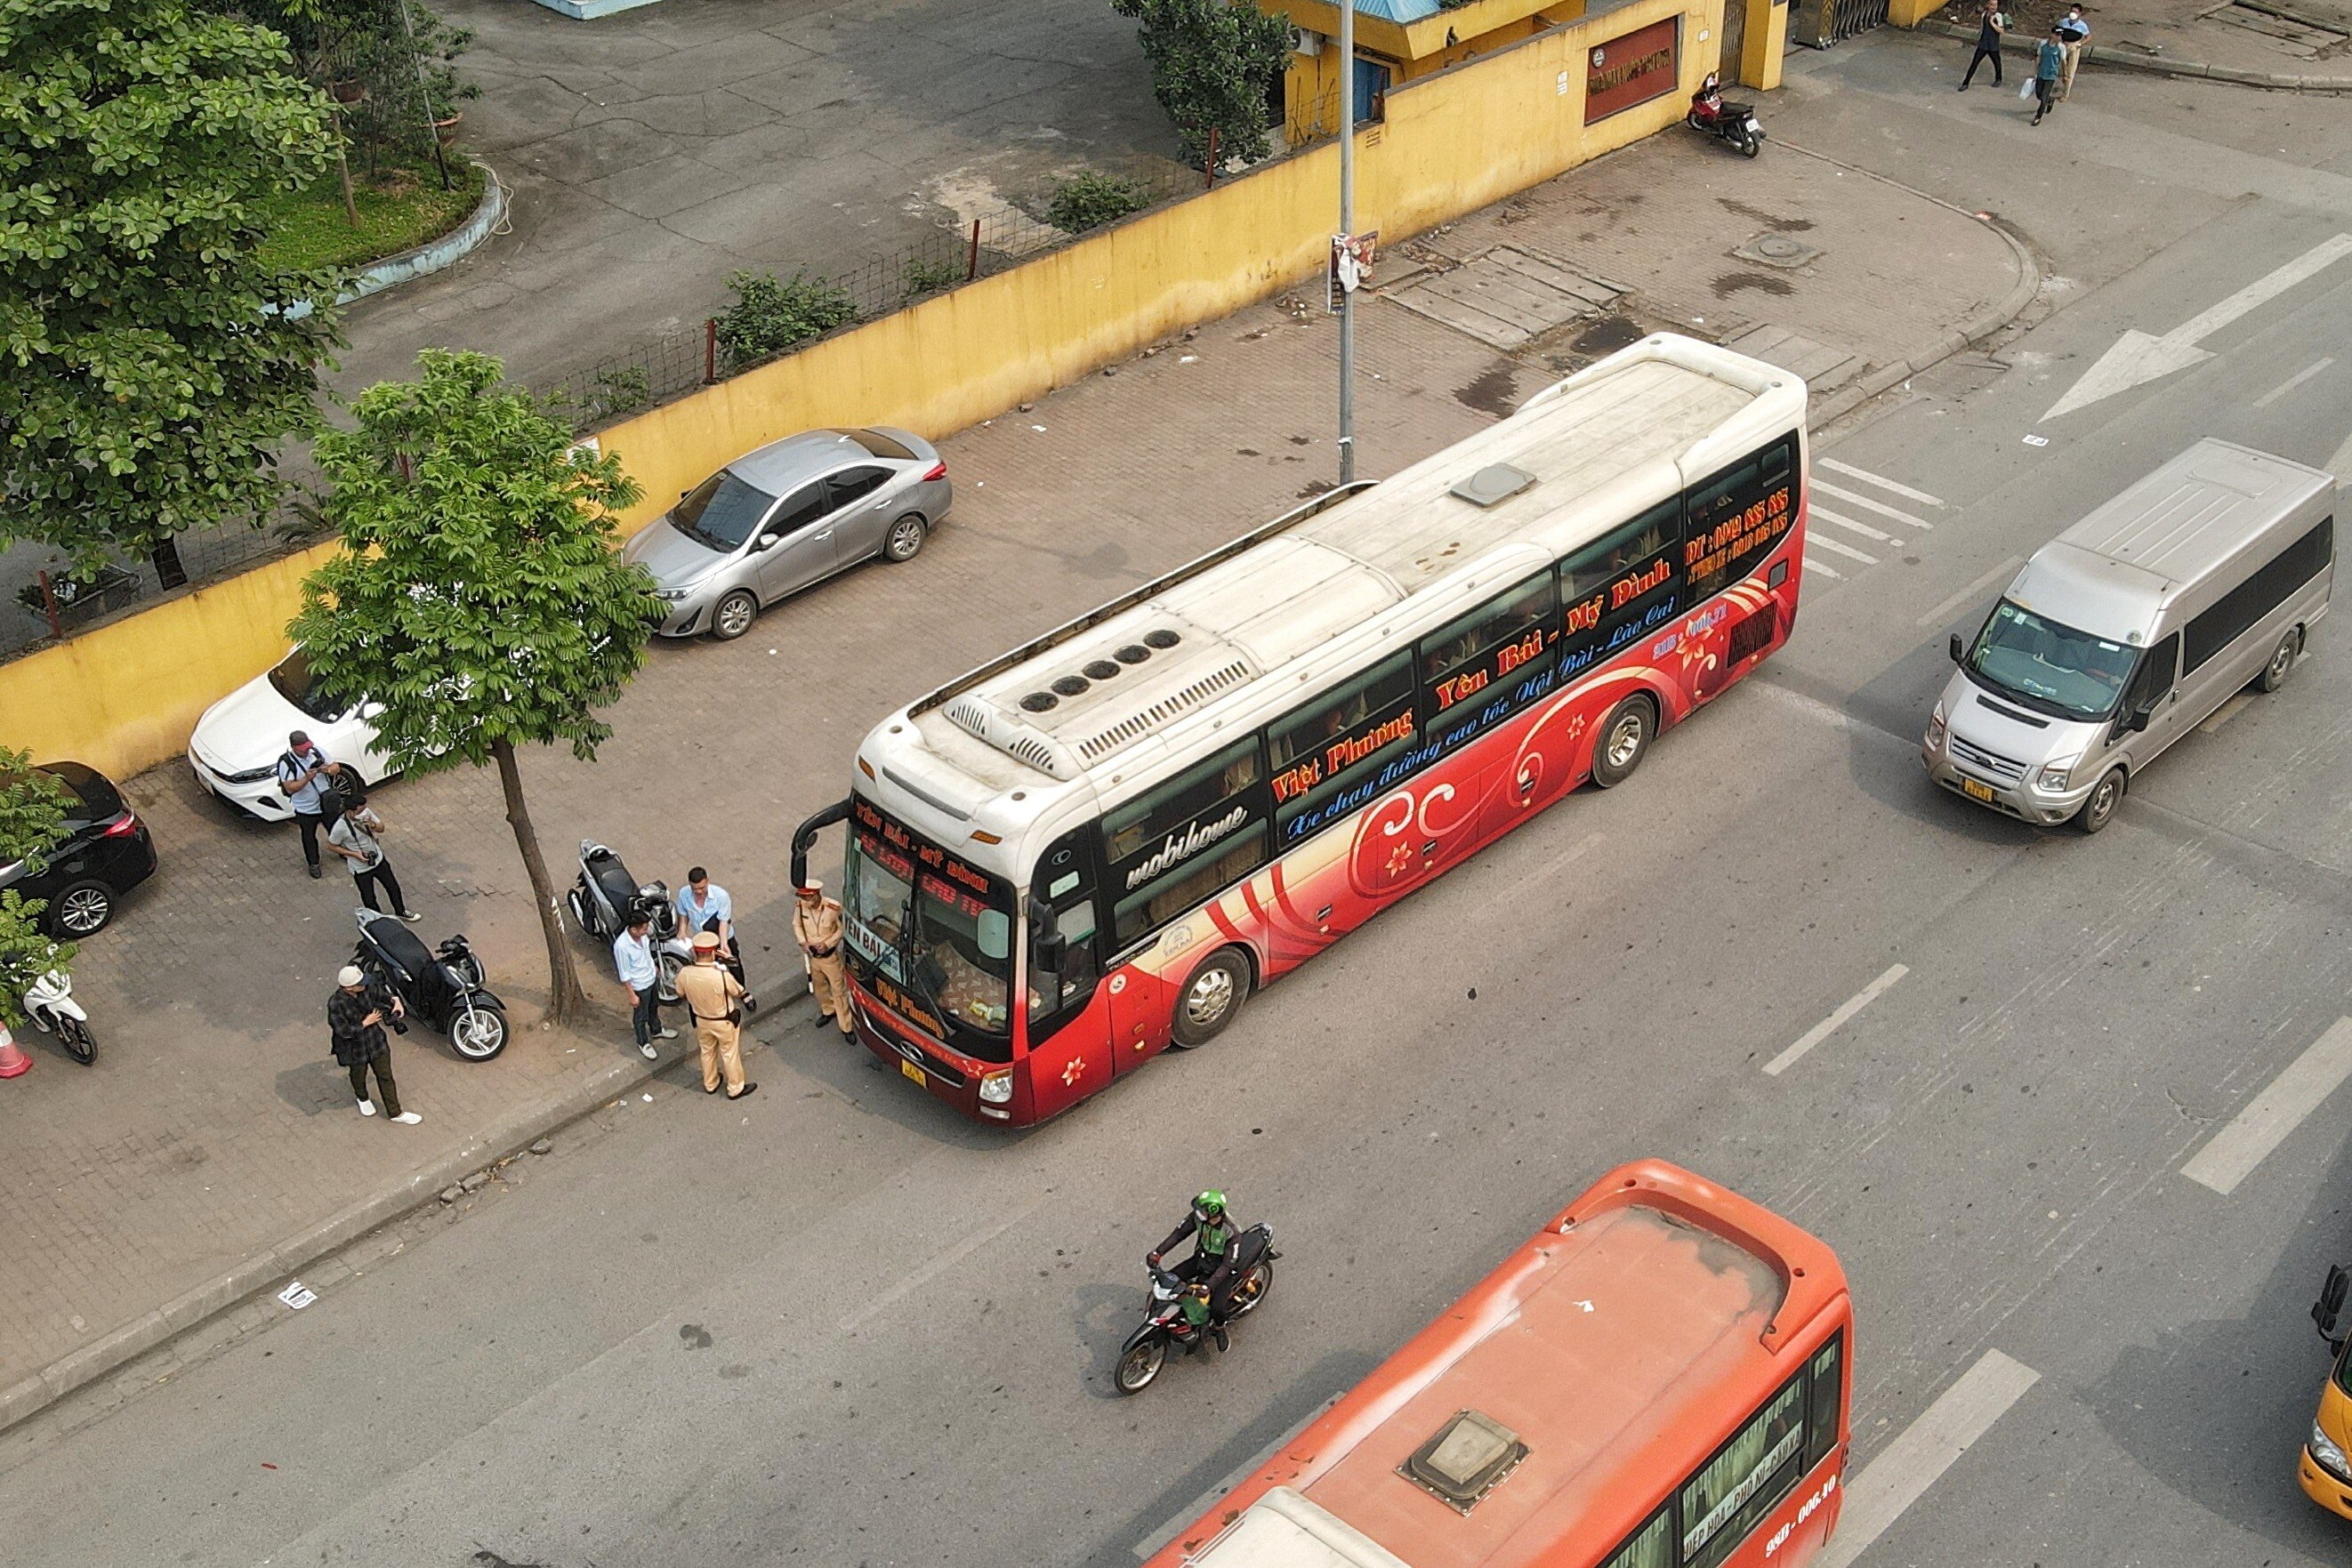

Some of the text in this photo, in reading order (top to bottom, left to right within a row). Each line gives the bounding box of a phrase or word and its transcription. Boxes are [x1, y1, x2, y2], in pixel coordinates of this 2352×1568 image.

[1271, 758, 1323, 803] Việt
[1326, 707, 1414, 776] Phương
[1436, 669, 1488, 712] Yên
[1497, 629, 1543, 677] Bái
[1566, 594, 1605, 636] Mỹ
[1611, 558, 1671, 610] Đình
[1287, 810, 1321, 840] Xe
[1325, 780, 1375, 818] chạy
[1446, 719, 1477, 746] cao
[1482, 696, 1510, 725] tốc
[1559, 645, 1594, 677] Bài
[1606, 621, 1641, 650] Lào
[1646, 596, 1674, 625] Cai
[856, 802, 882, 831] YÊN
[1126, 806, 1247, 889] mobifone
